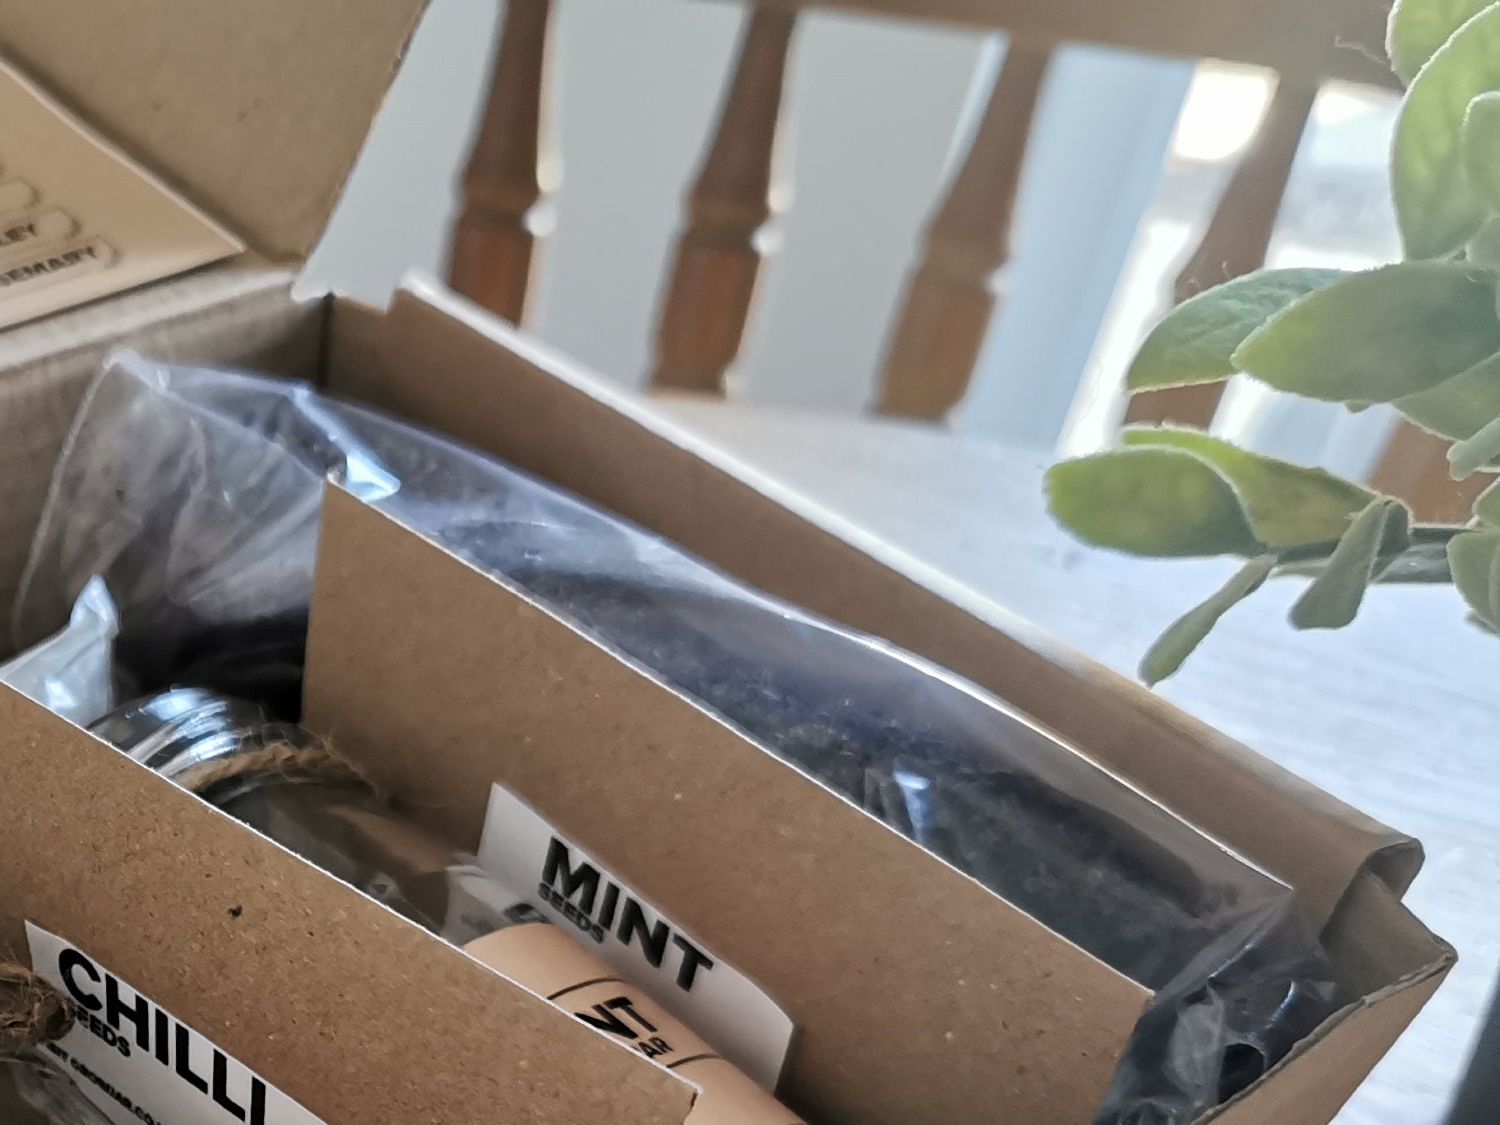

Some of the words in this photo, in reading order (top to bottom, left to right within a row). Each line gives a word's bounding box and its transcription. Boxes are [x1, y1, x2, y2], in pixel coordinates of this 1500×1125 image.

[538, 881, 605, 944] SEEDS
[542, 836, 715, 993] MINT
[75, 1004, 131, 1057] EEDS
[632, 1036, 675, 1059] AR
